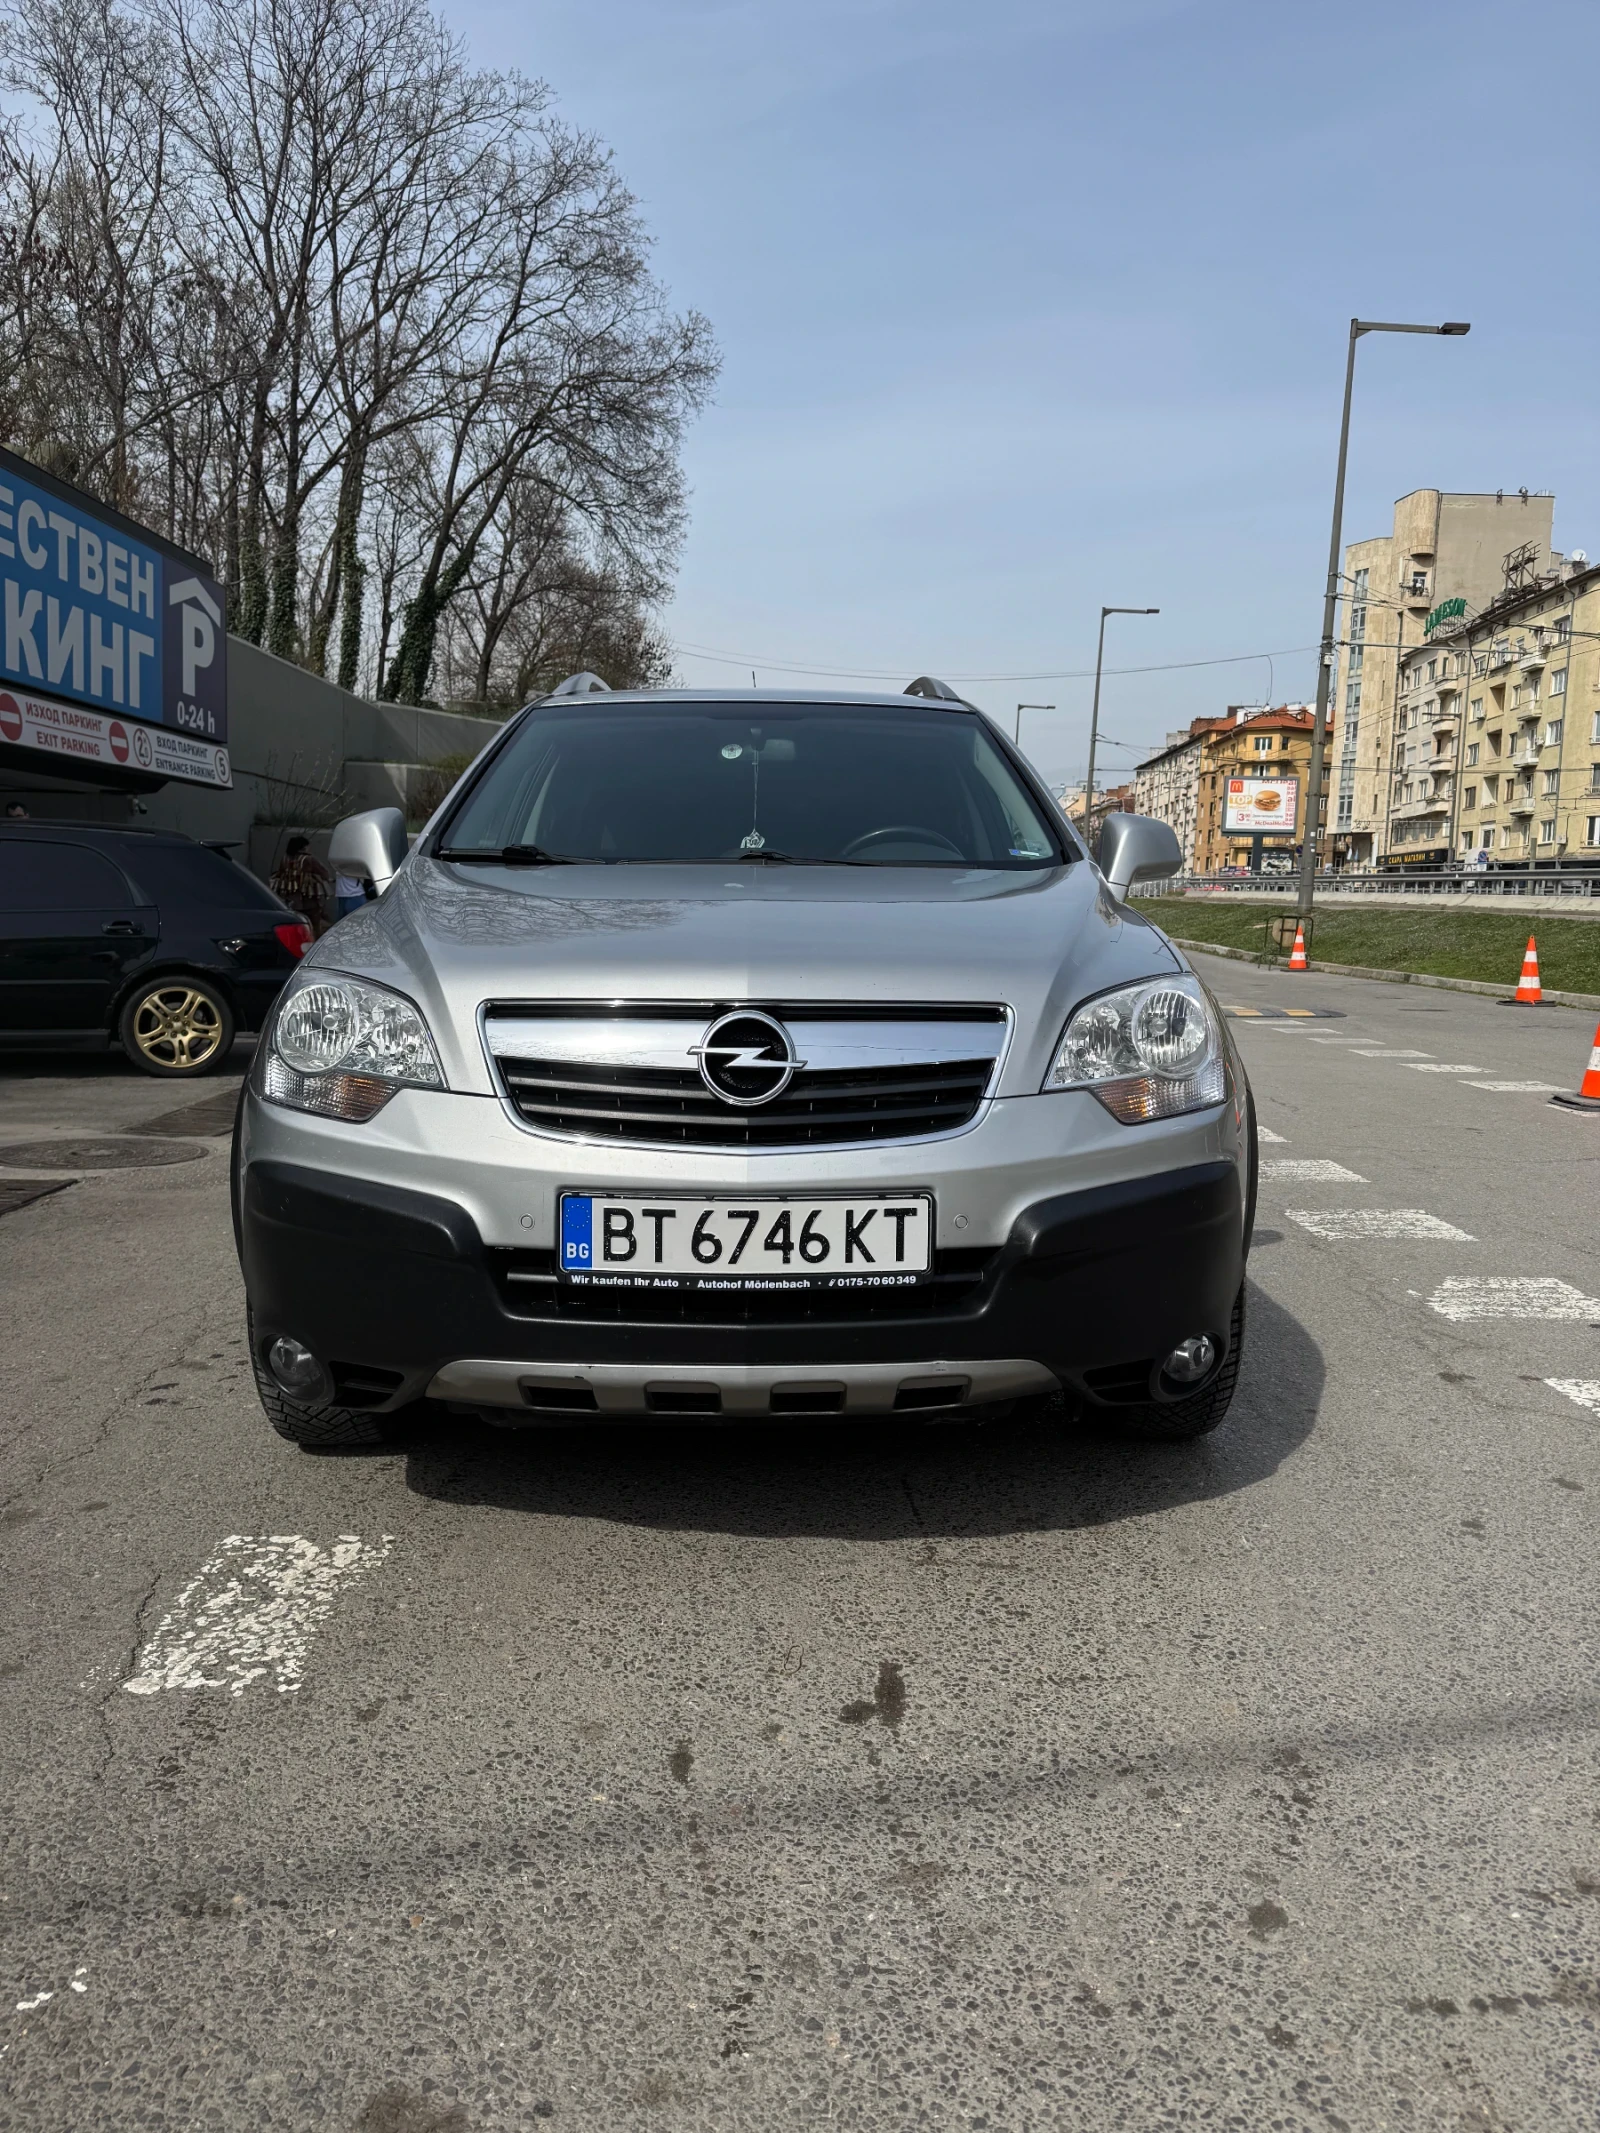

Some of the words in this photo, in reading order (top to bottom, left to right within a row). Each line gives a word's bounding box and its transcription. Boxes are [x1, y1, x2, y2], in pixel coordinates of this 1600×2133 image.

[5, 578, 154, 709] КИНГ
[182, 602, 214, 697] P
[25, 701, 60, 725] ИЗХОД
[61, 709, 102, 732] ПАРКИНГ
[177, 701, 205, 731] 0-24
[207, 710, 215, 734] h
[36, 730, 58, 748] EXIT
[61, 736, 100, 756] PARKING
[156, 736, 177, 754] ВХОД
[177, 742, 208, 759] ПАРКИНГ
[155, 757, 190, 776] ENTRANCE
[189, 764, 215, 780] PARKING
[218, 757, 226, 776] 5
[1231, 795, 1251, 804] TOP
[566, 1242, 589, 1259] BG
[603, 1207, 676, 1263] BT
[691, 1209, 830, 1264] 6746
[844, 1207, 918, 1264] KT
[571, 1275, 589, 1284] Wir
[592, 1276, 631, 1286] kaufen
[634, 1277, 650, 1286] Ihr
[653, 1278, 679, 1287] Auto
[697, 1279, 742, 1289] Autohof
[744, 1280, 811, 1289] Mörlenbach
